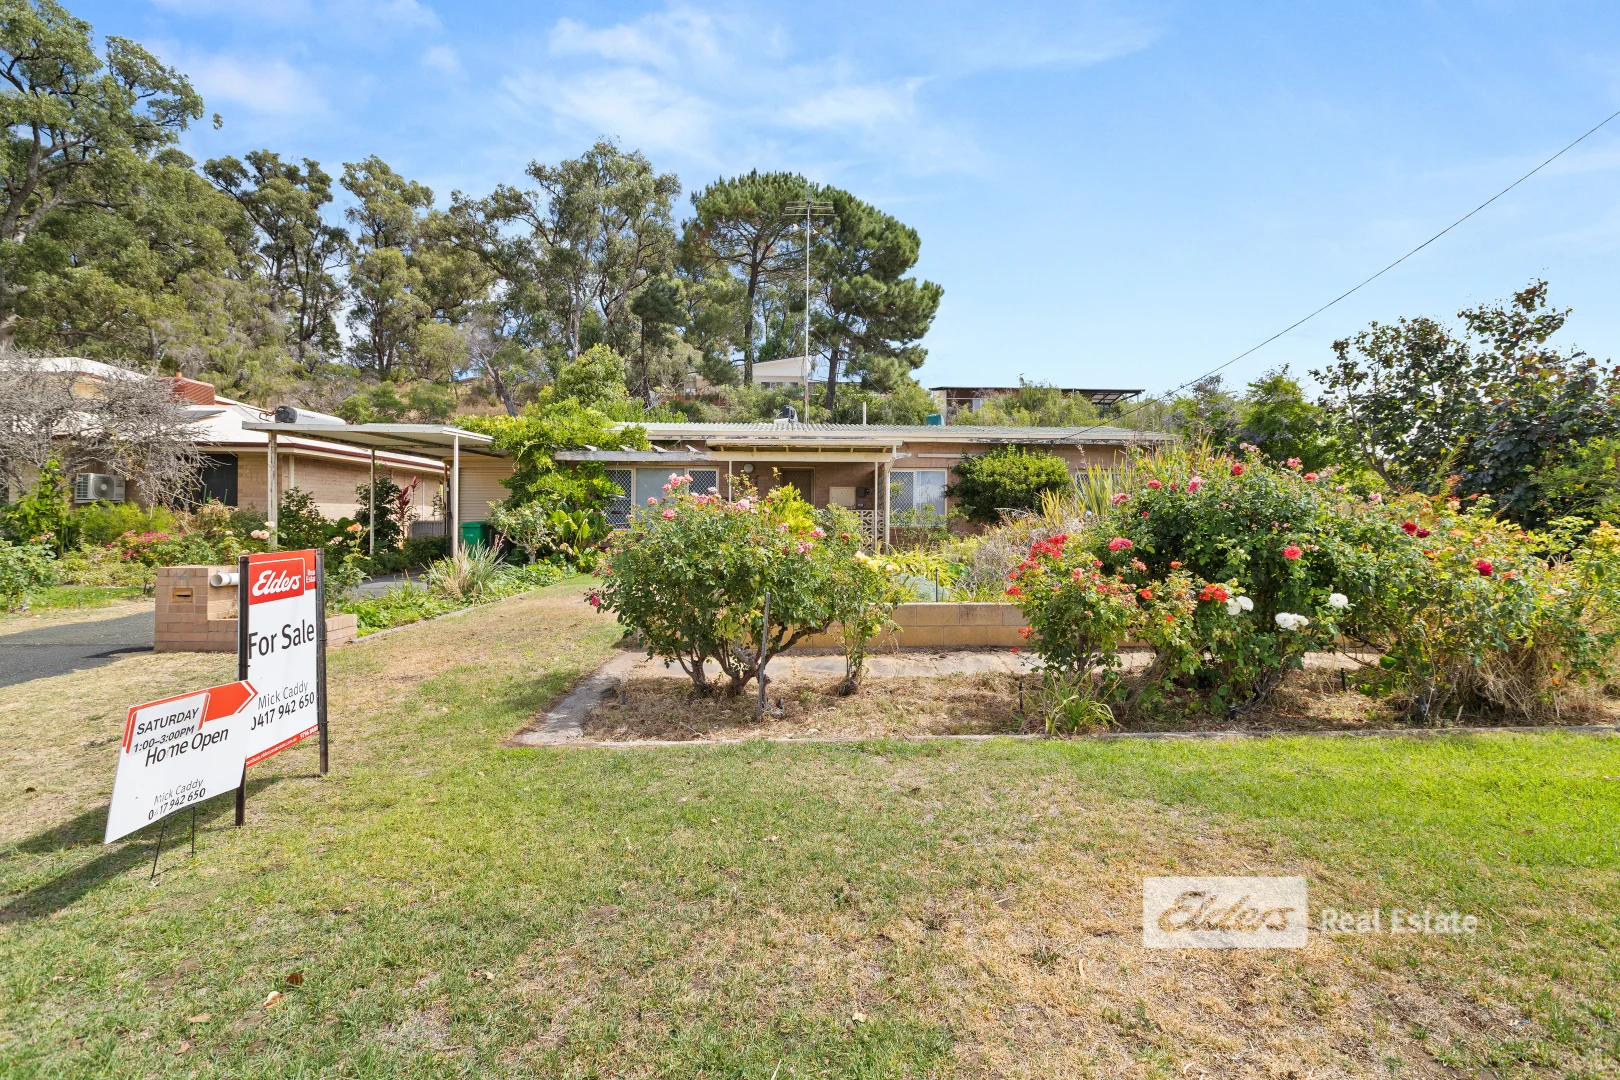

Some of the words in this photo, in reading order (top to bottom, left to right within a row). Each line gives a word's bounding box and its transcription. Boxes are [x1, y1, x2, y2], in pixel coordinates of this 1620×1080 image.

[252, 569, 301, 597] Elders
[248, 631, 277, 660] For
[281, 619, 315, 650] Sale
[257, 690, 281, 710] Mick
[282, 680, 309, 700] Caddy
[278, 699, 297, 720] 942
[298, 691, 315, 710] 650
[136, 707, 200, 736] SATURDAY
[144, 740, 189, 768] Home
[191, 728, 229, 752] Open
[153, 788, 174, 806] Mick
[175, 778, 204, 796] Caddy
[169, 794, 186, 811] 942
[187, 787, 206, 802] 650
